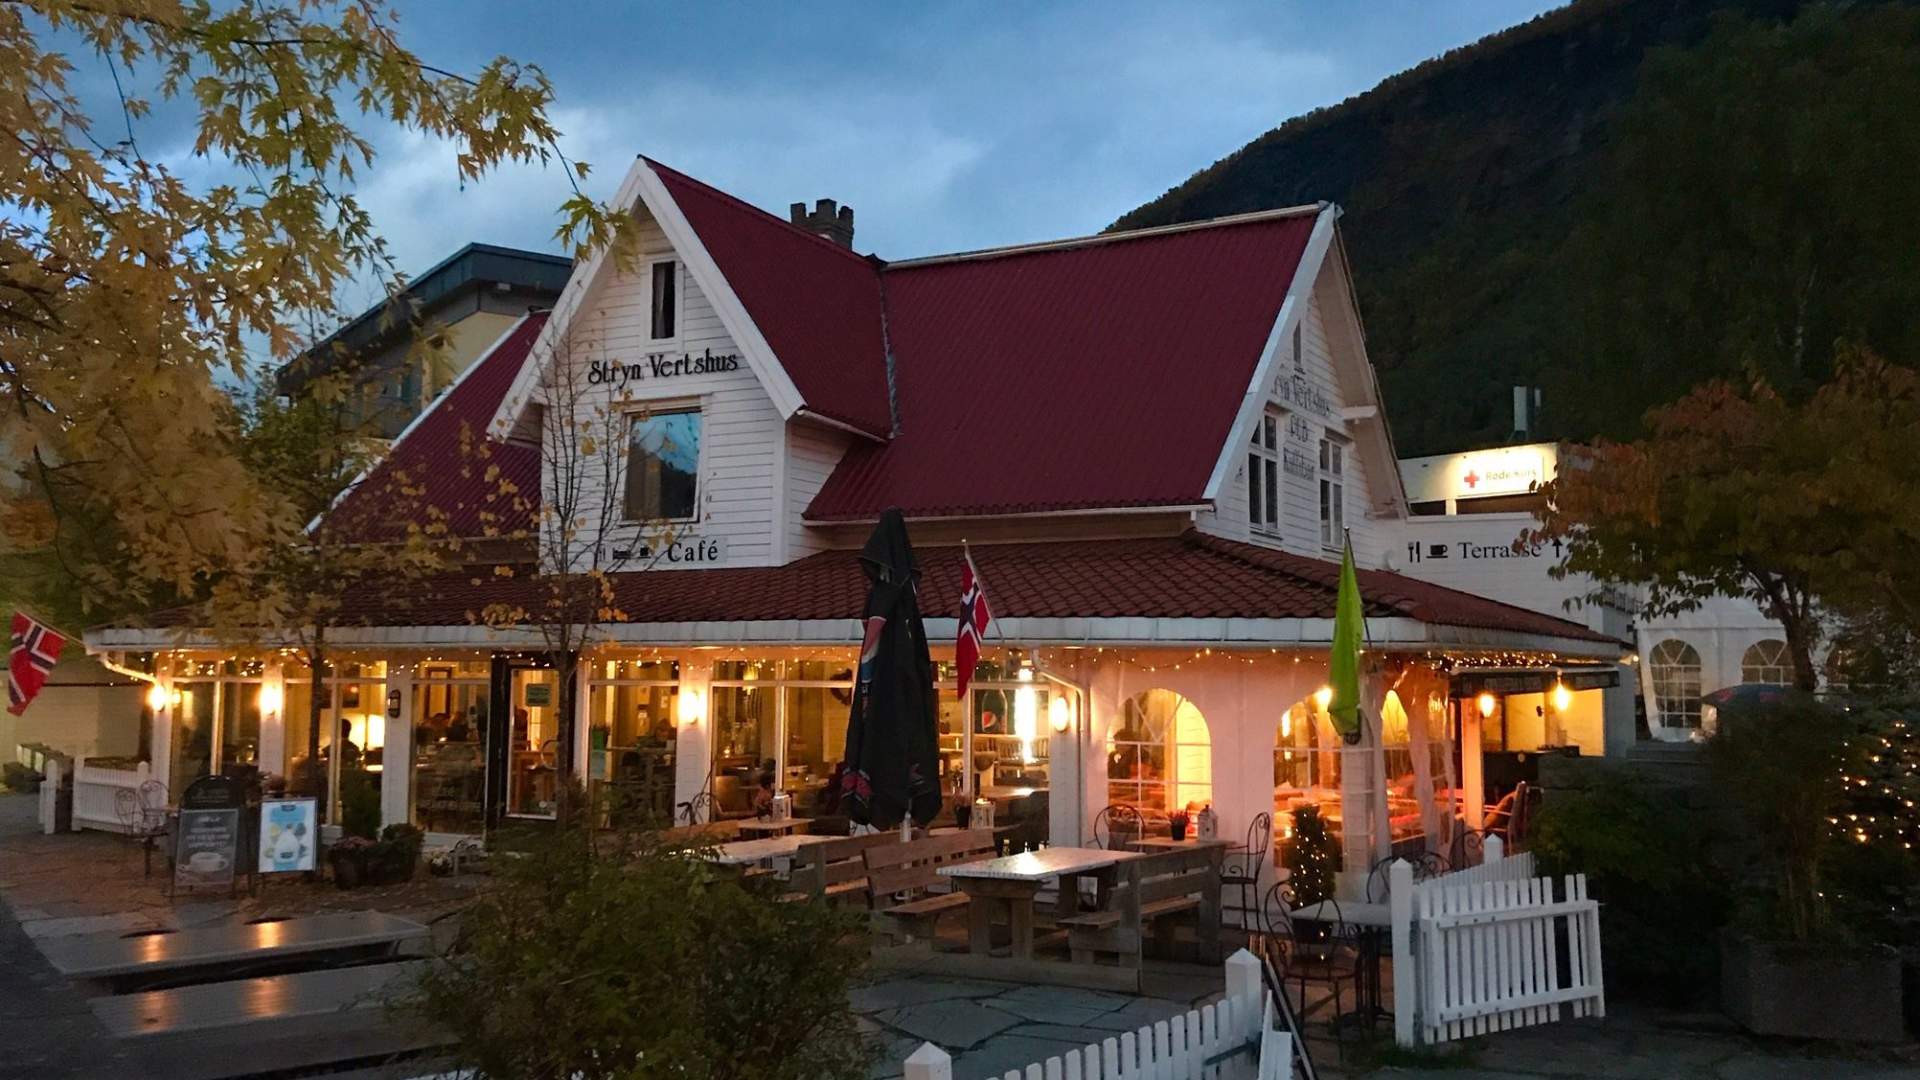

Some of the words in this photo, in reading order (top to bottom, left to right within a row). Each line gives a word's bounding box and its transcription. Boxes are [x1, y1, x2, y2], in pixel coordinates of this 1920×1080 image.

[588, 360, 642, 390] Stryn
[649, 348, 738, 378] Vertshus
[667, 540, 718, 562] Café
[1457, 541, 1542, 560] Terrase
